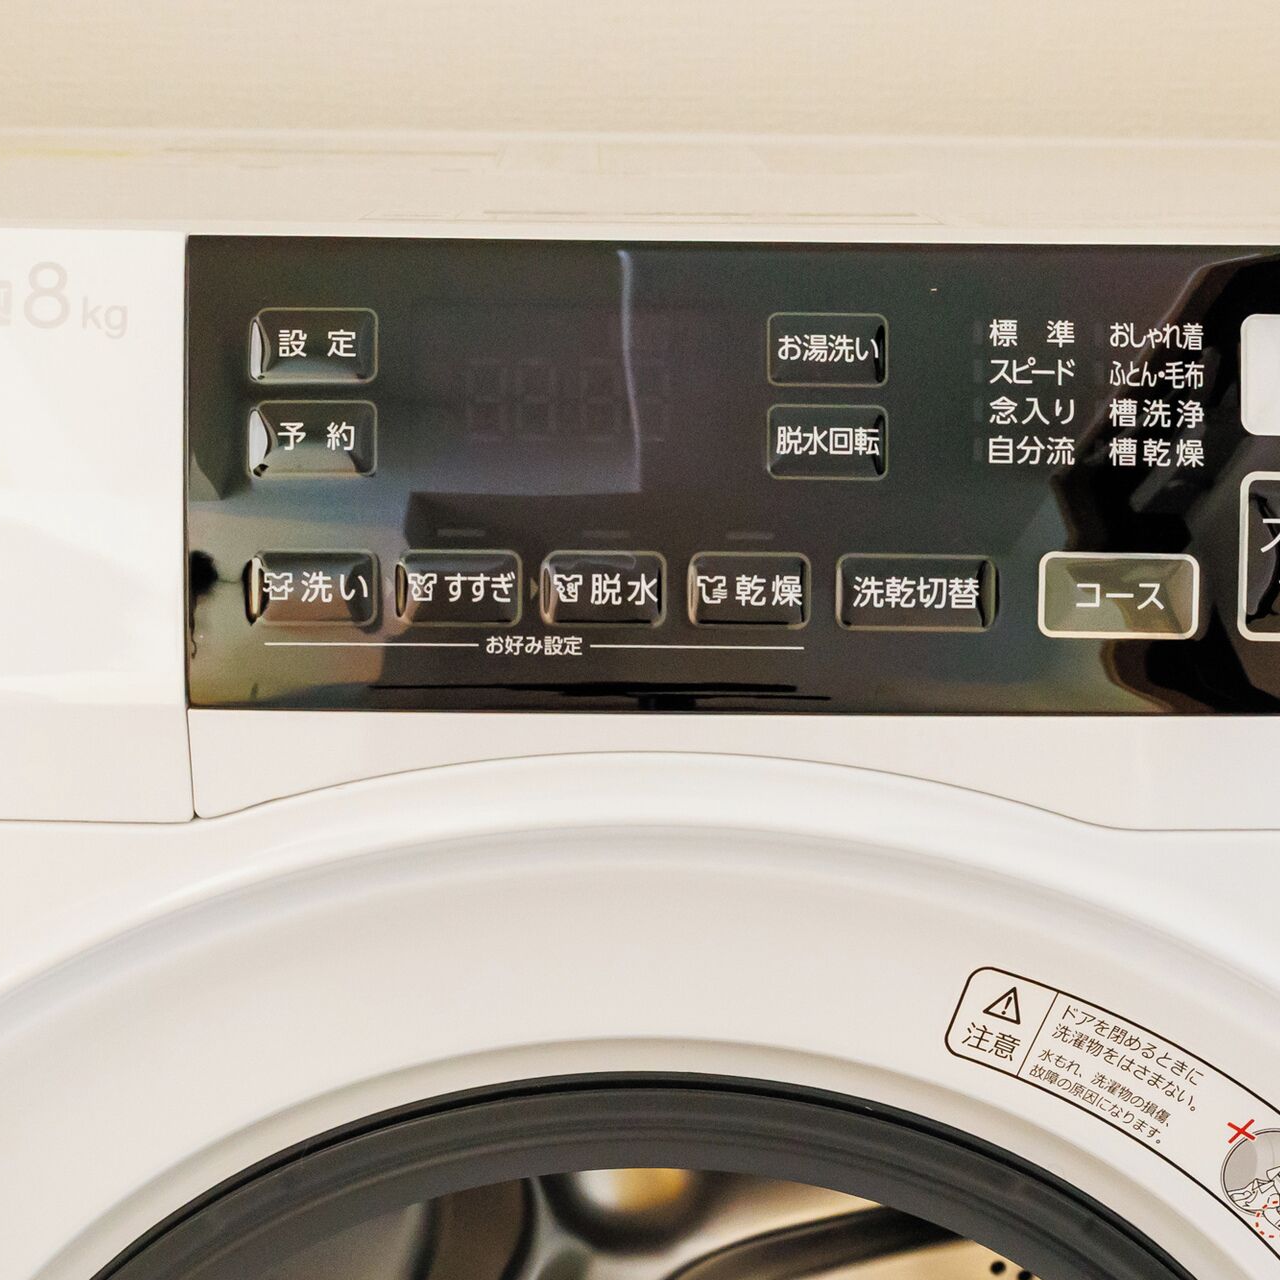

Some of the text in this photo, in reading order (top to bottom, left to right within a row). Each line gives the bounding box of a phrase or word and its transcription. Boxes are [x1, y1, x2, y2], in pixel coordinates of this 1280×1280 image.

[23, 261, 128, 339] 8 kg
[278, 329, 357, 358] 設定
[777, 333, 880, 362] お湯洗い
[989, 319, 1075, 347] 標準
[1110, 322, 1204, 350] おしゃれ着
[990, 357, 1075, 385] スピード
[1110, 361, 1205, 389] ふとん・毛布
[989, 396, 1075, 425] 念入り
[1109, 399, 1204, 428] 槽洗浄
[277, 422, 357, 451] 予約
[776, 426, 880, 456] 脱水回転
[989, 435, 1075, 465] 自分流
[1109, 438, 1204, 468] 槽乾燥
[301, 571, 368, 602] 洗い
[444, 572, 516, 602] すすぎ
[591, 574, 659, 605] 脱水
[735, 576, 803, 606] 乾燥
[852, 577, 980, 610] 洗乾切替
[1077, 583, 1165, 610] コース
[486, 636, 583, 656] お好み設定
[961, 1021, 1021, 1062] 注意
[1061, 1003, 1205, 1086] ドアを閉めるときに
